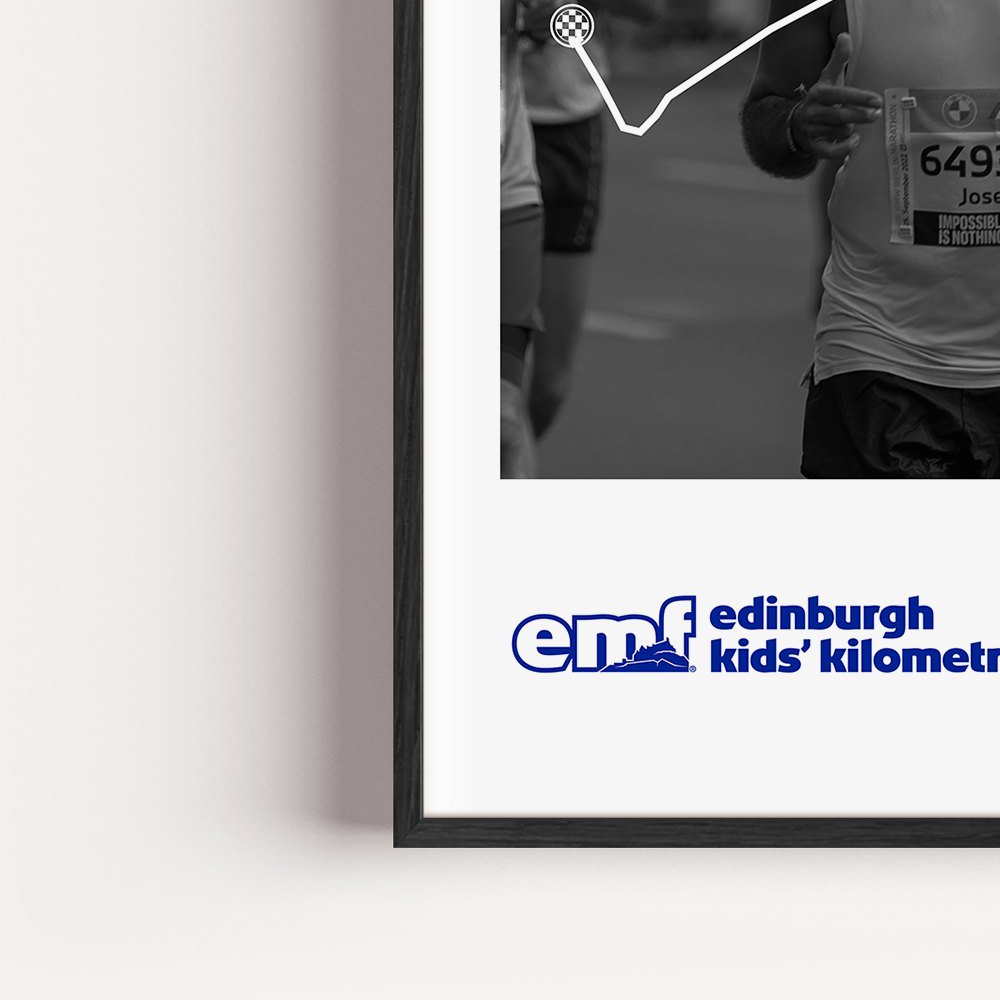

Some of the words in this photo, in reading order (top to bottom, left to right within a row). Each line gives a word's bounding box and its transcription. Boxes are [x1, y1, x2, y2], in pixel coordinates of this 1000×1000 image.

[938, 230, 951, 245] IS
[511, 595, 697, 674] emf
[709, 595, 934, 639] edinburgh
[710, 637, 812, 674] kids’
